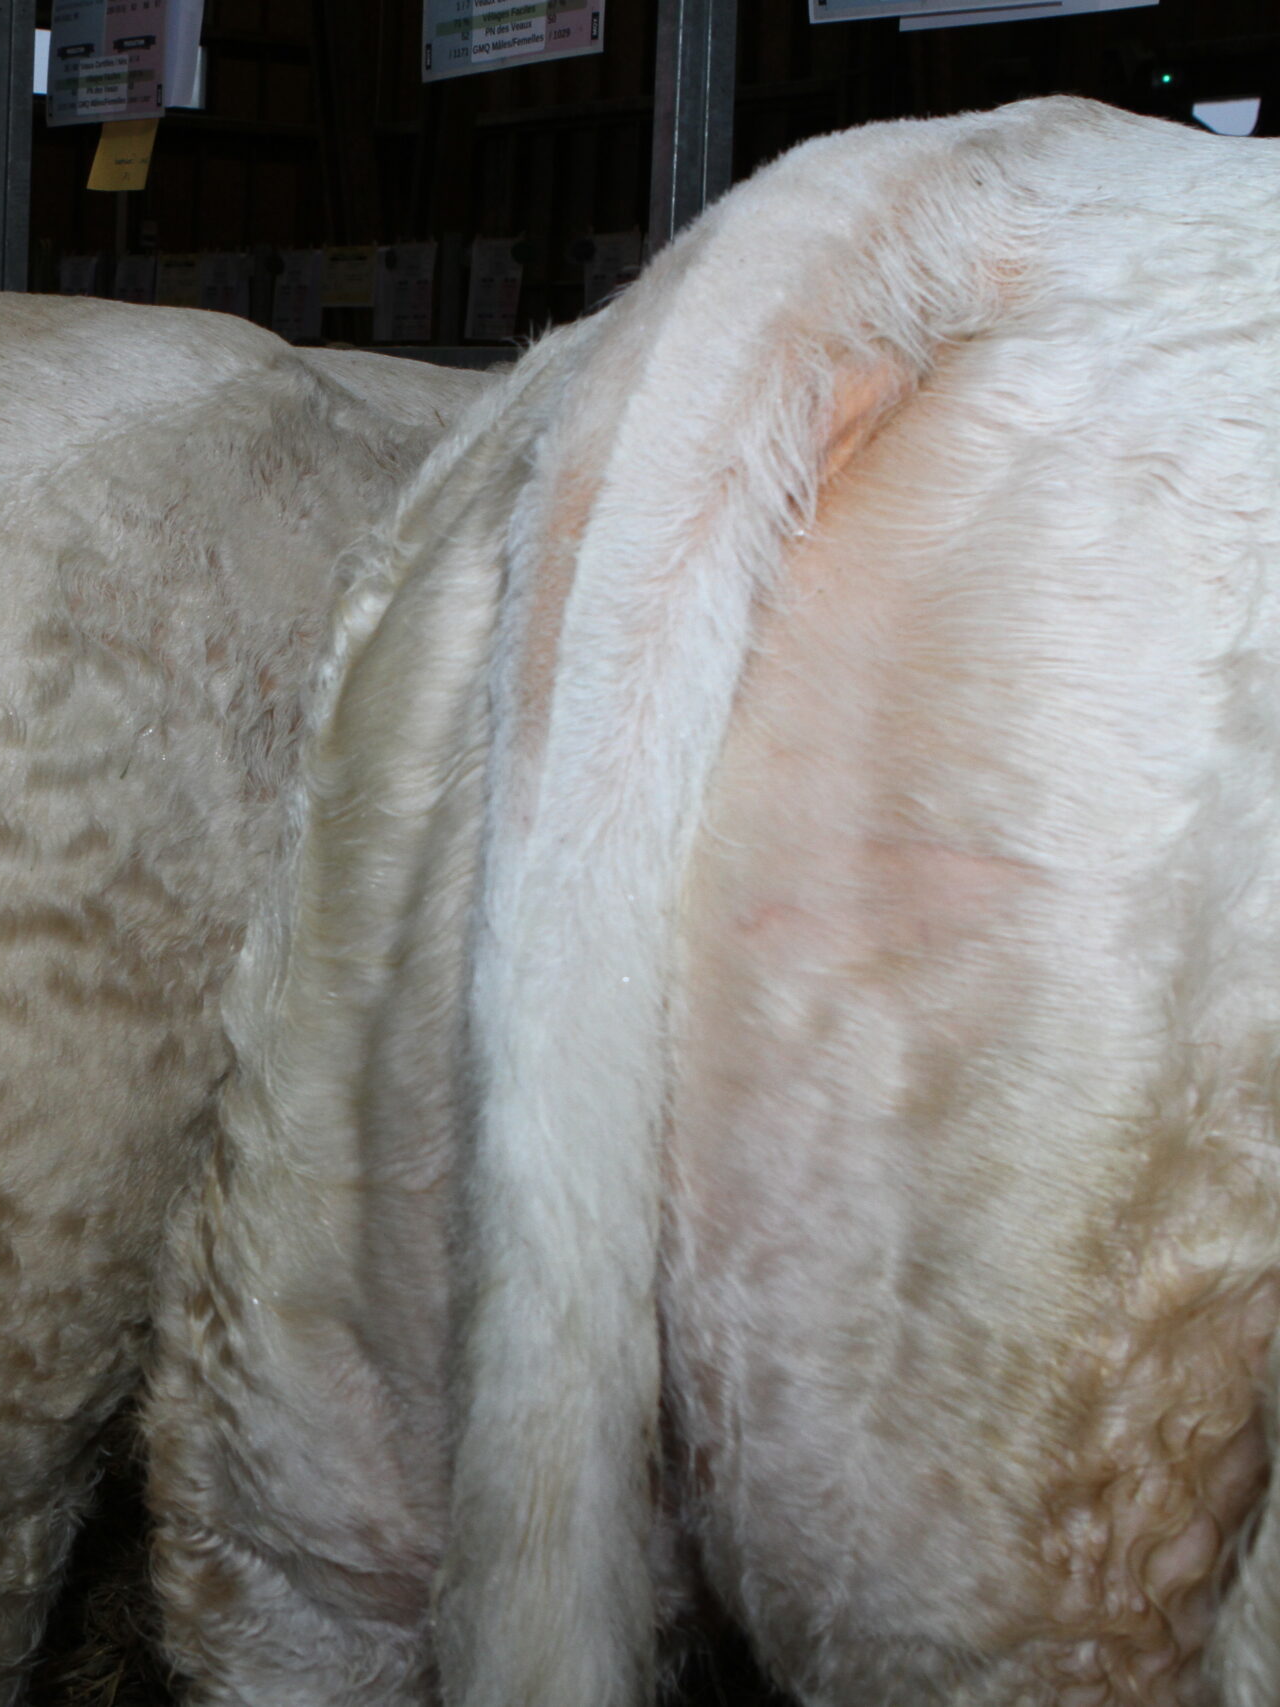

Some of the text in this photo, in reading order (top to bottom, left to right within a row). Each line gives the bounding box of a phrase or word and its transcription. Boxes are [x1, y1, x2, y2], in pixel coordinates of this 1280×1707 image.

[485, 27, 496, 37] PN
[511, 21, 532, 32] Veaux
[472, 43, 491, 55] GMQ
